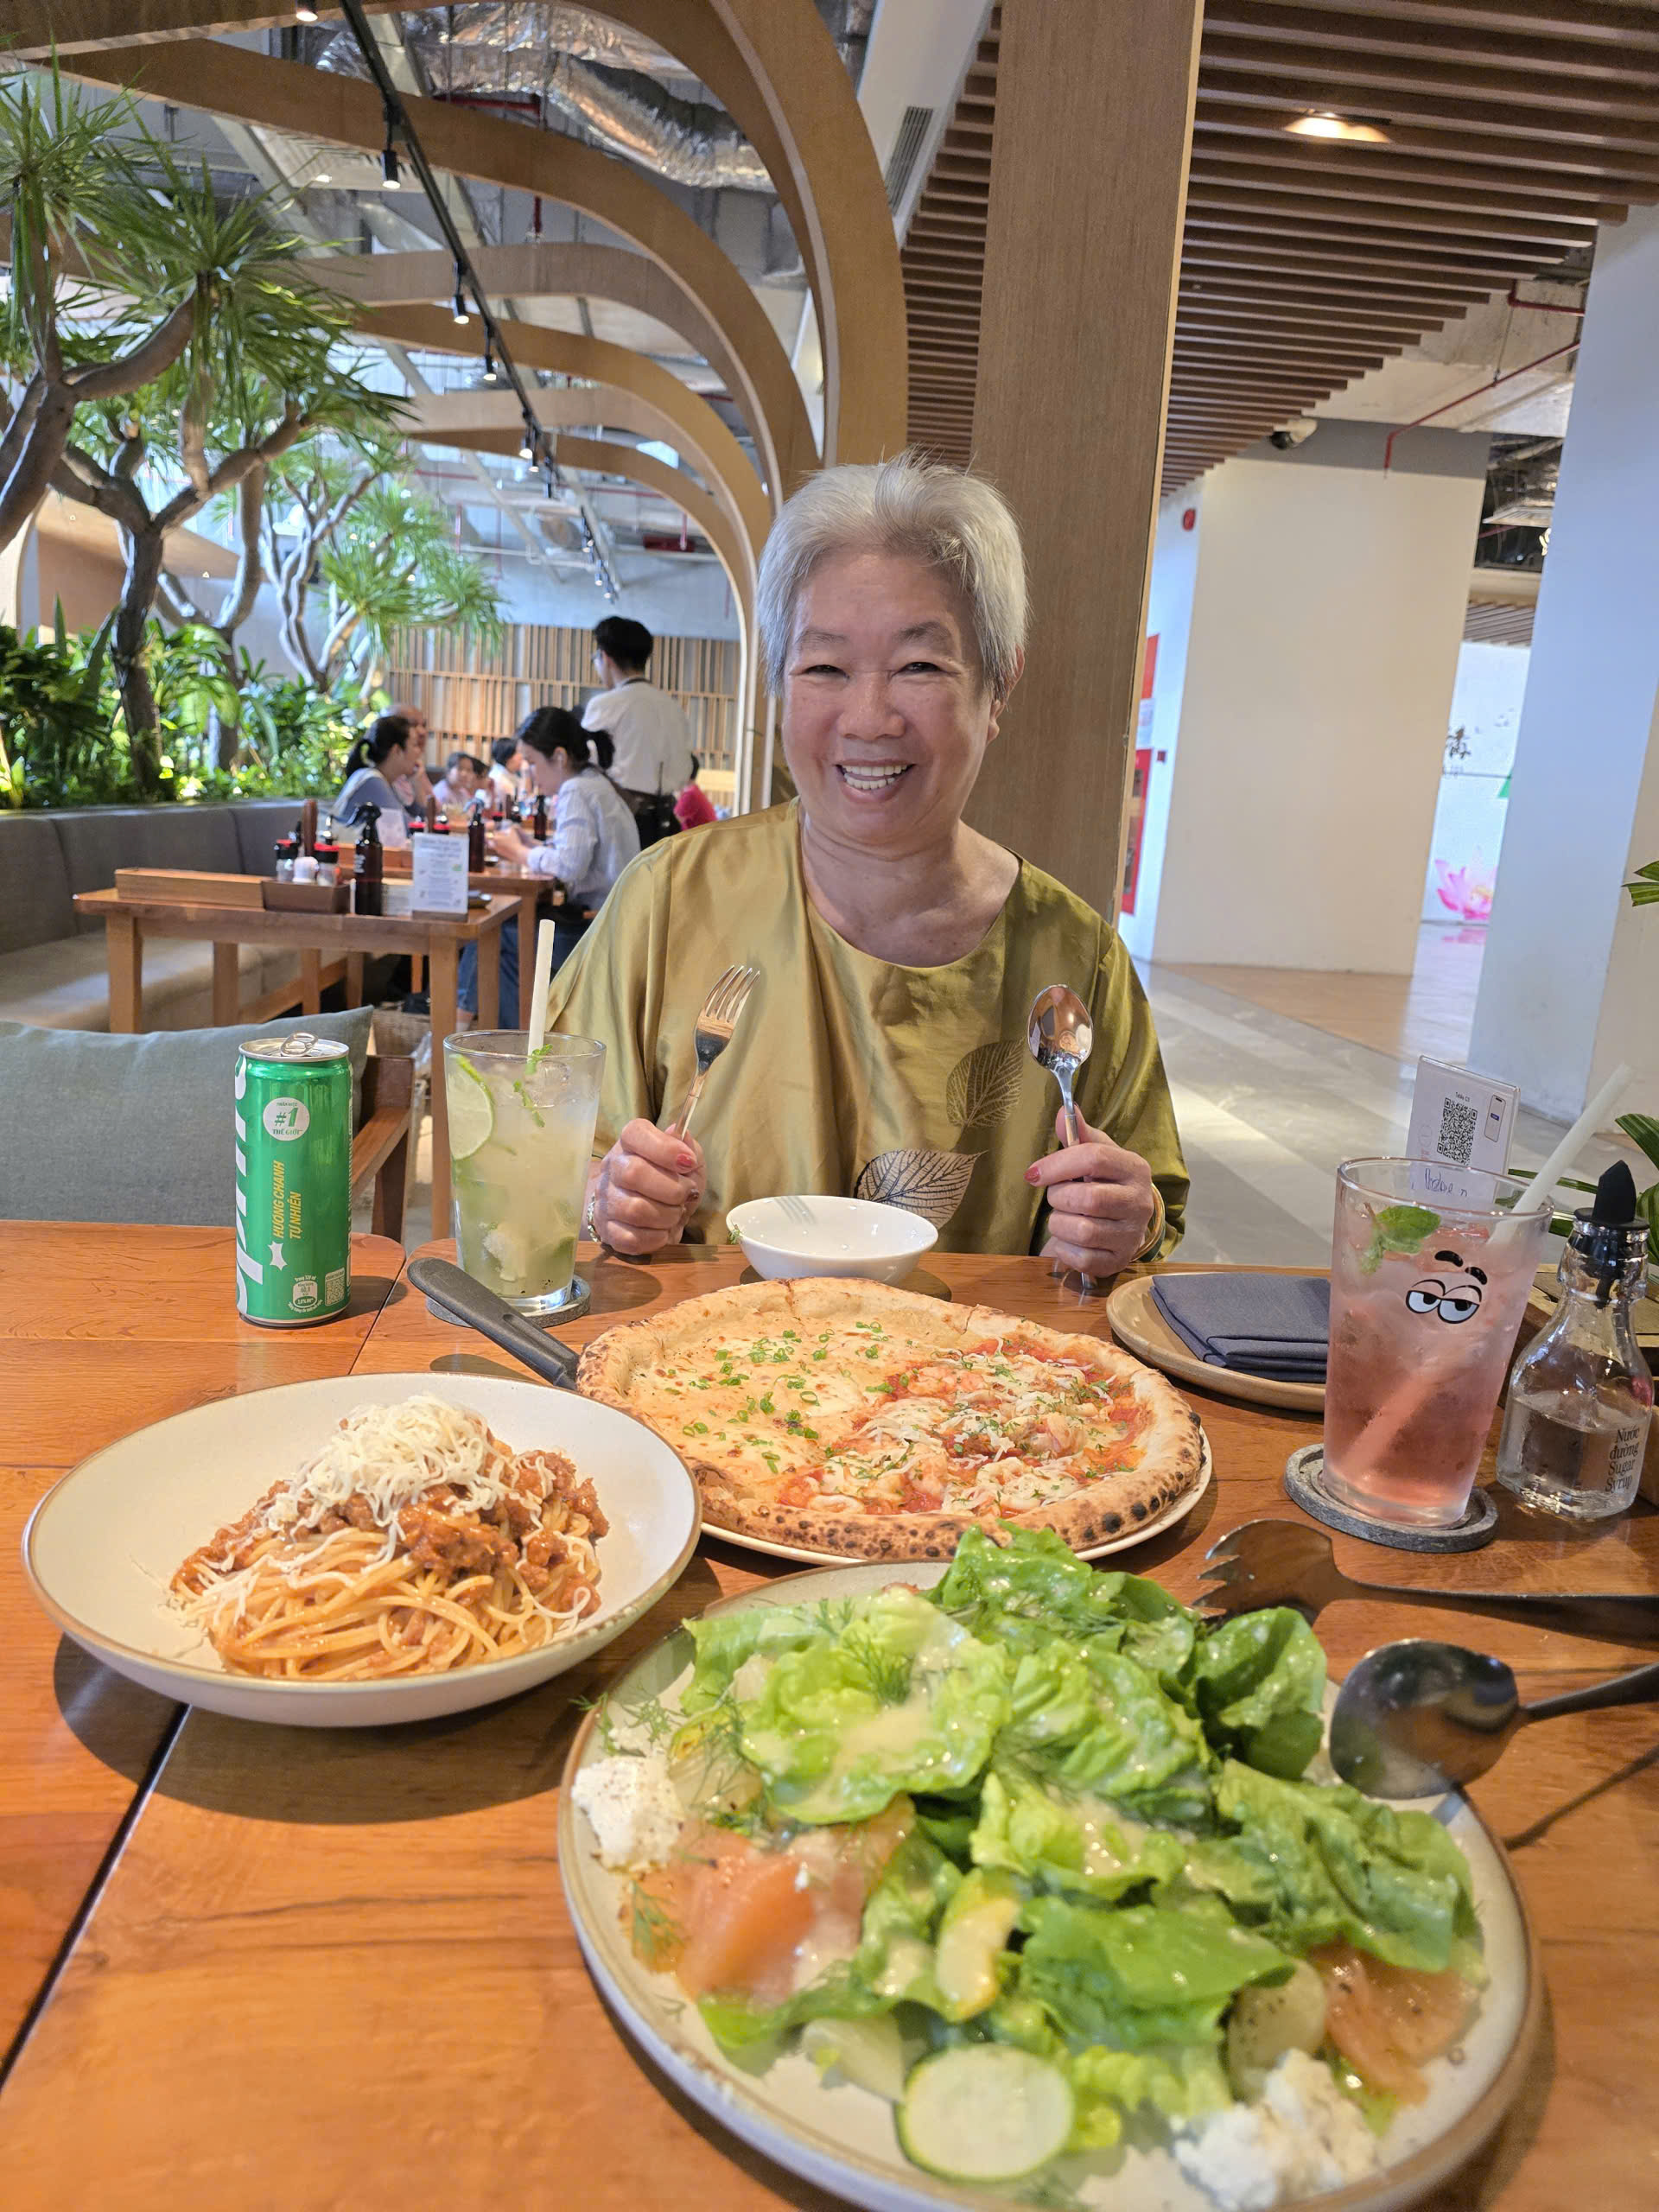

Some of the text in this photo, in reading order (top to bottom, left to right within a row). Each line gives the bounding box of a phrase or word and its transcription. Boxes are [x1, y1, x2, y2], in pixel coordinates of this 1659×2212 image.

[274, 1107, 298, 1127] #1
[272, 1160, 284, 1239] HƯƠNG CHANH
[287, 1191, 303, 1239] TỰ NHIÊN
[1614, 1425, 1640, 1443] Nước
[1610, 1443, 1639, 1460] đường
[1608, 1459, 1635, 1476] Sugar
[1605, 1475, 1632, 1493] Syrup
